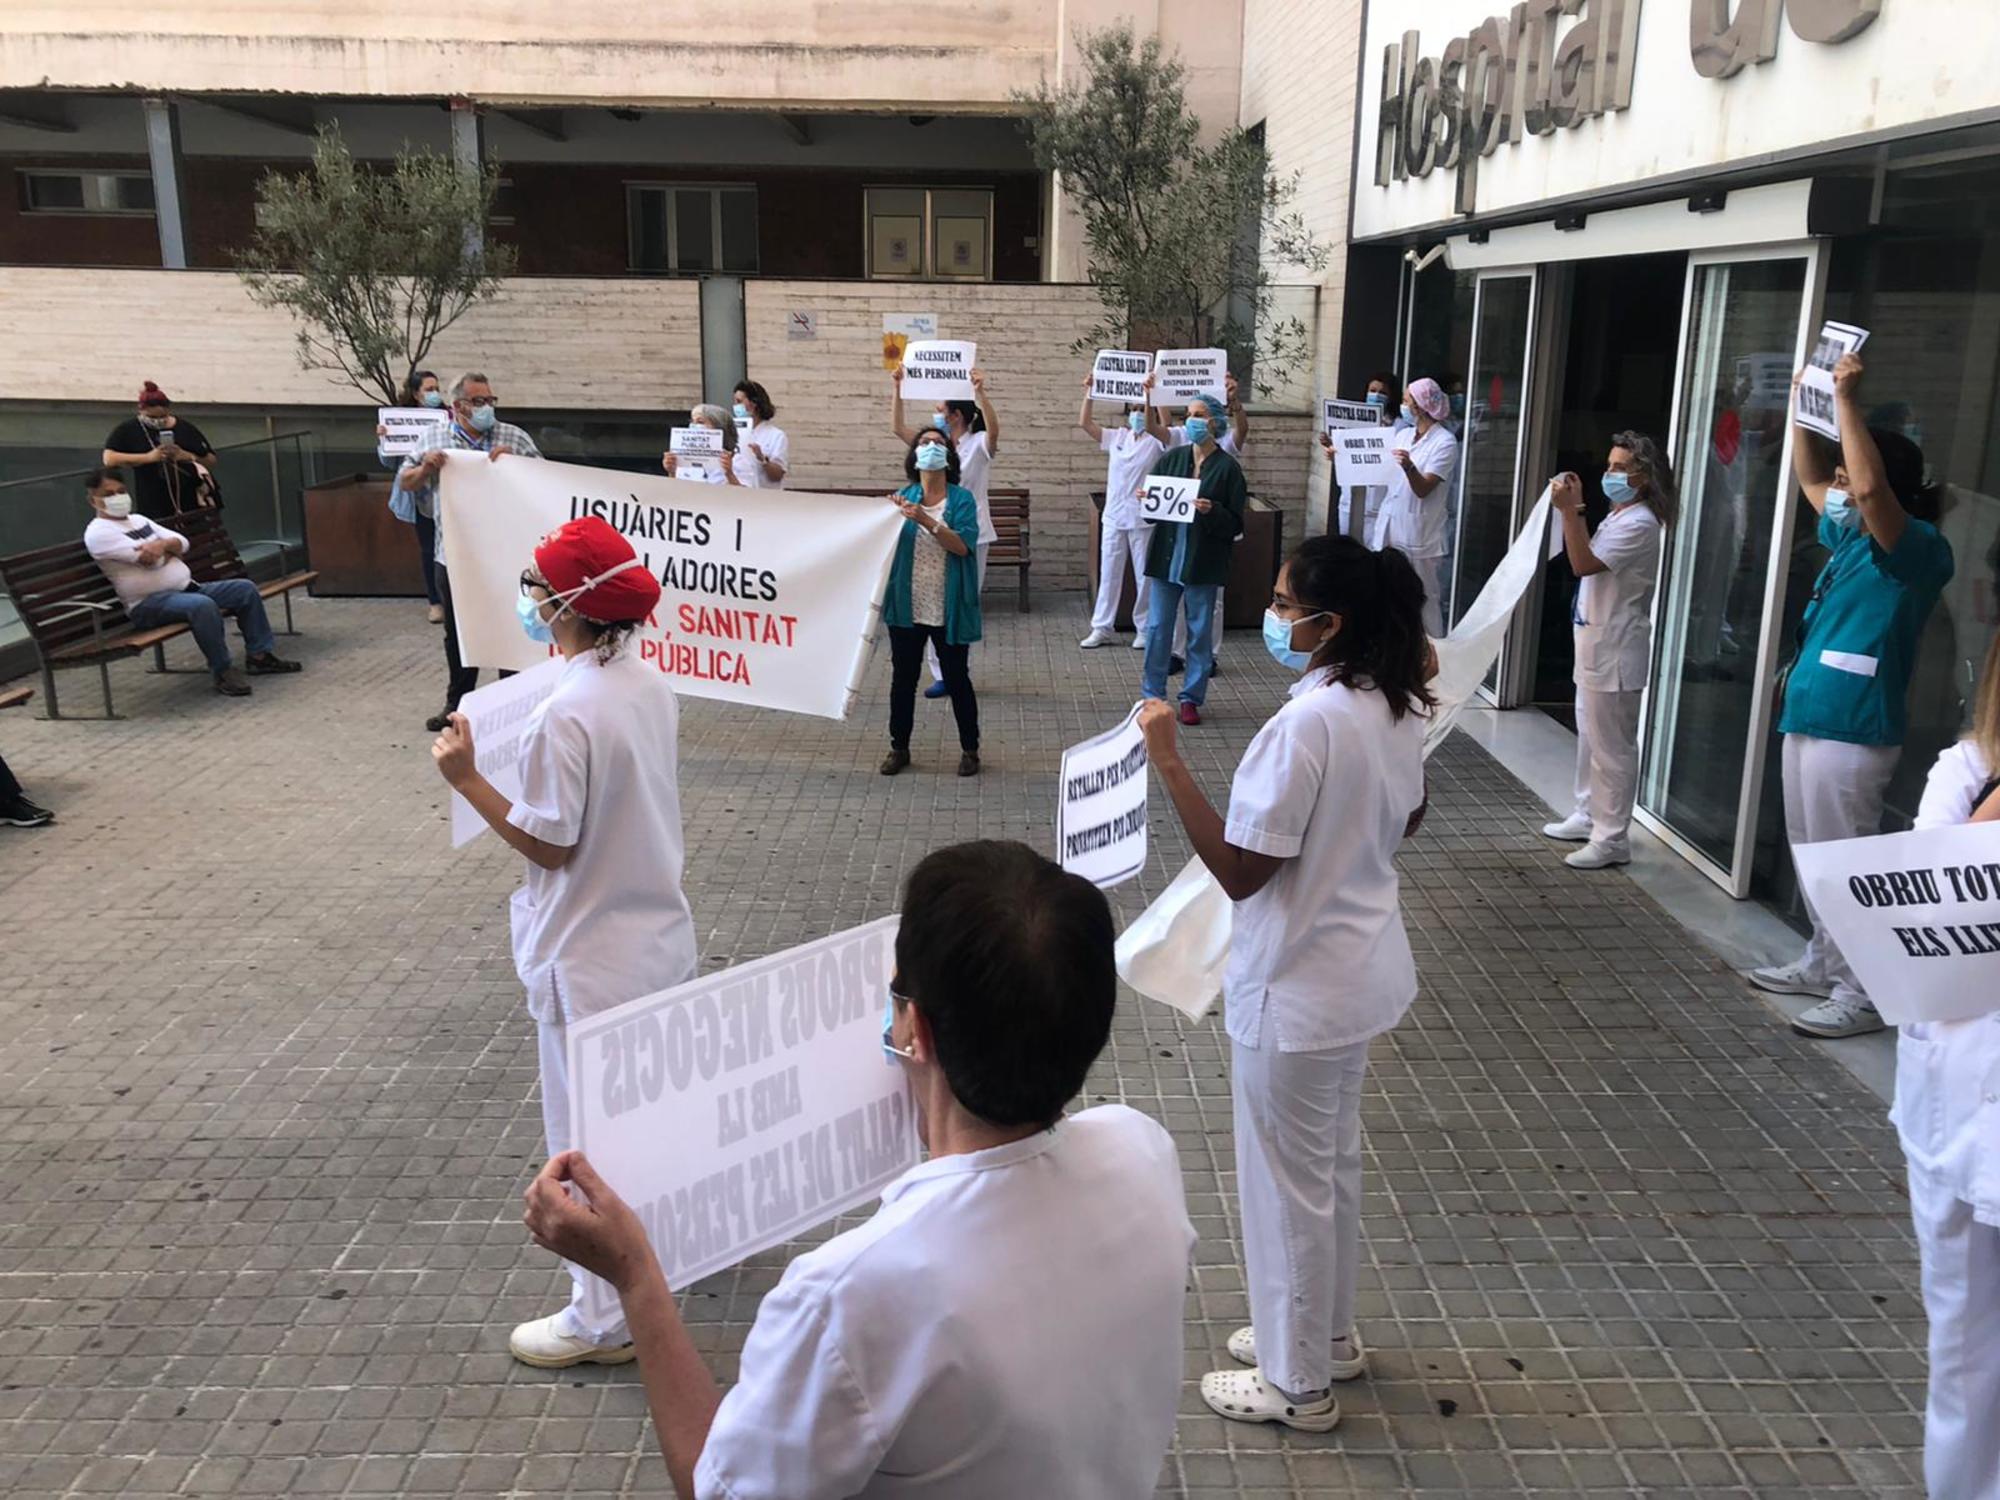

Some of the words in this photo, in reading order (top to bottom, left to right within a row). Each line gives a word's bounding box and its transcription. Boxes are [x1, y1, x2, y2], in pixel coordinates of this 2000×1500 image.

[1375, 0, 1642, 216] Hospital
[913, 350, 962, 363] NECESSITEM
[924, 367, 968, 381] PERSONAL
[1095, 379, 1105, 393] NO
[1106, 379, 1114, 394] SE
[1145, 486, 1189, 516] 5%
[569, 494, 712, 547] USUÀRIES
[735, 518, 743, 552] I
[679, 603, 798, 648] SANITAT
[640, 631, 752, 686] PÚBLICA
[1849, 868, 1942, 908] OBRIU
[1892, 926, 1951, 957] ELS
